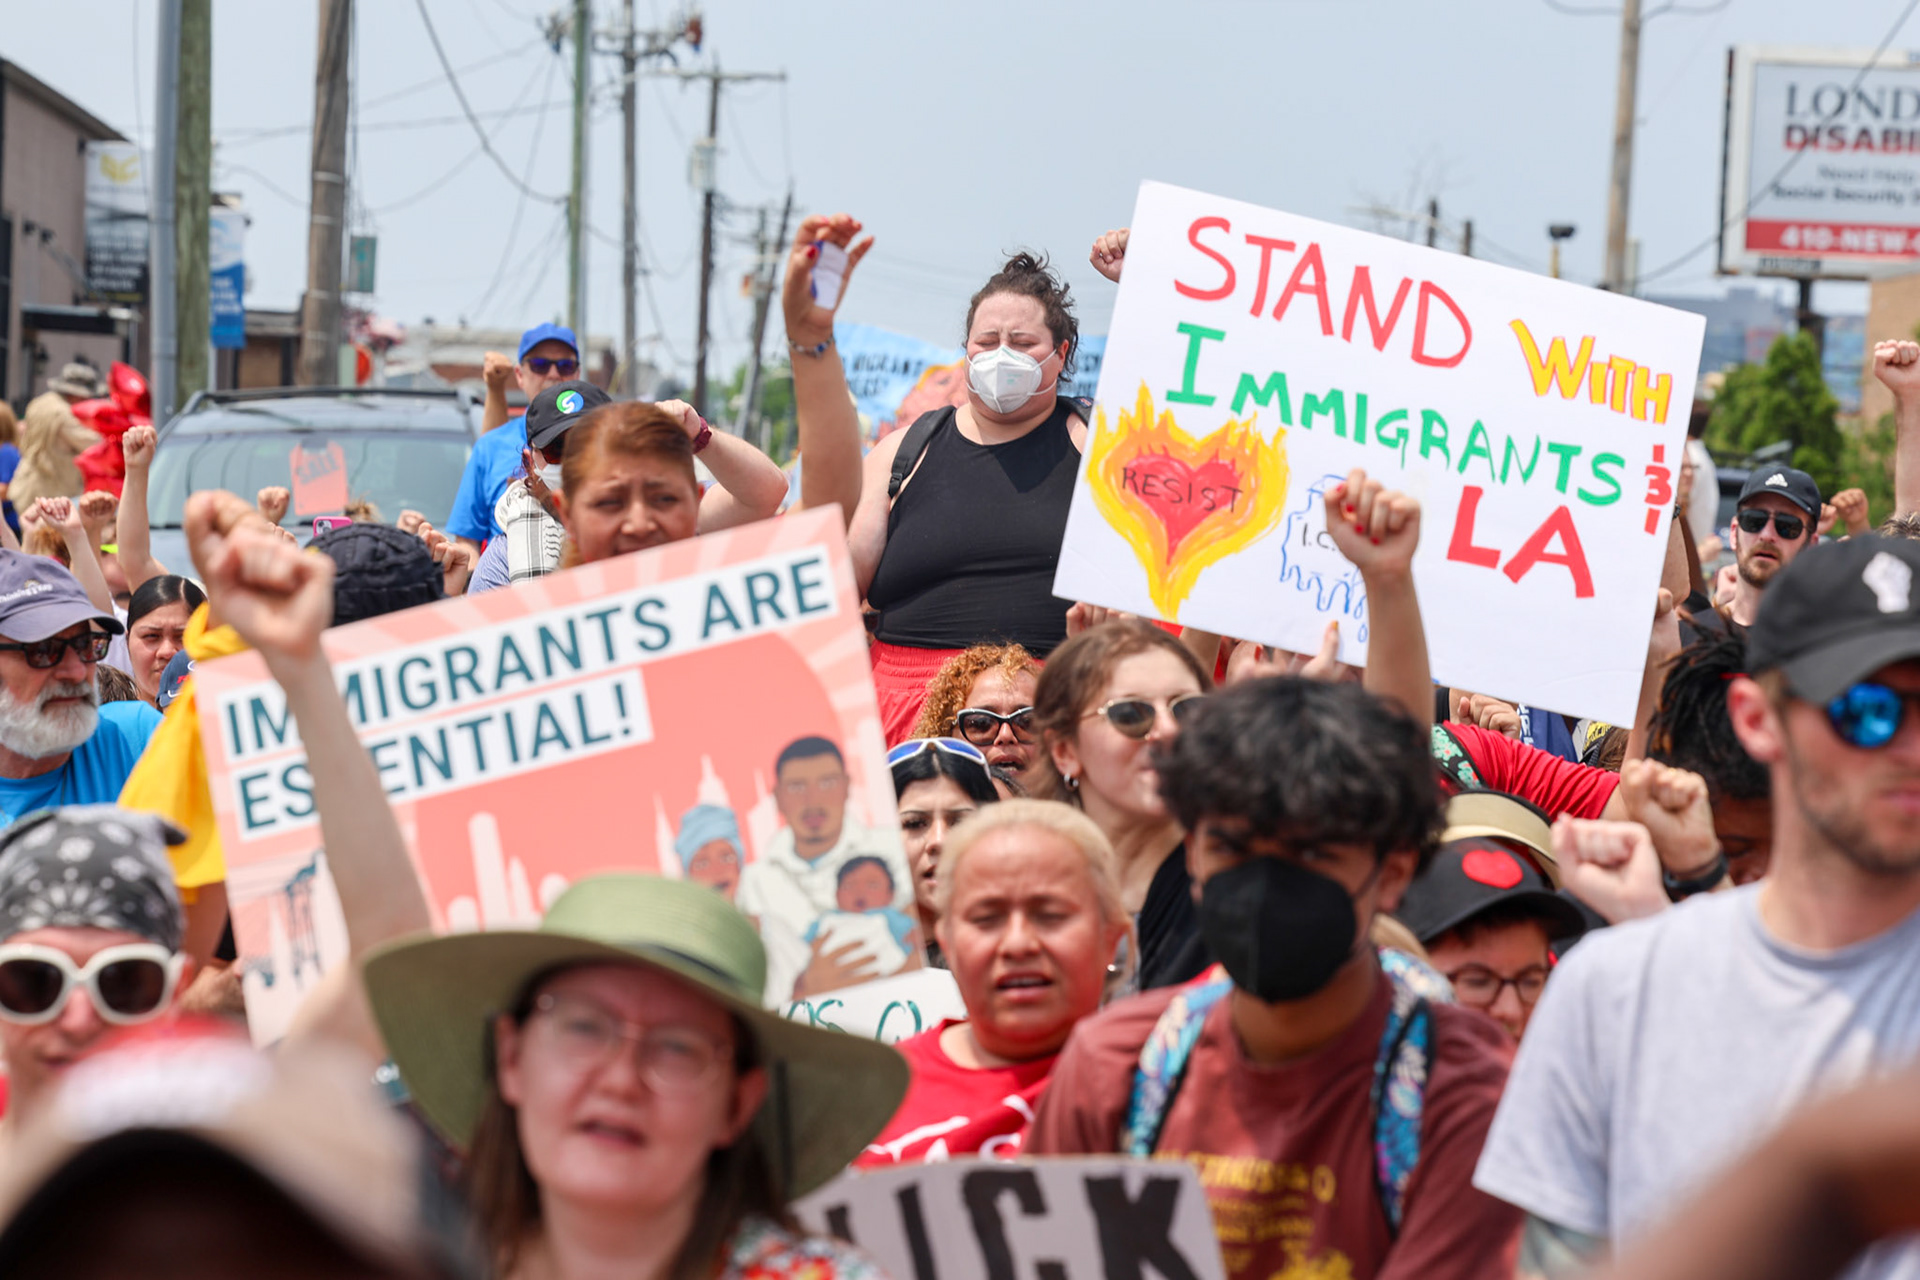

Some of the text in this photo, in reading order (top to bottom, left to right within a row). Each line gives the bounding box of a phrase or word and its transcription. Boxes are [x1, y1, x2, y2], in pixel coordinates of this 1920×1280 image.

[1785, 82, 1920, 121] LOND
[1174, 216, 1673, 425] STAND WITH
[1166, 322, 1626, 506] IMMIGRANTS
[1122, 467, 1243, 513] RESIST
[1446, 485, 1595, 599] LA
[700, 556, 831, 641] ARE
[239, 682, 632, 830] ESENTIAL!
